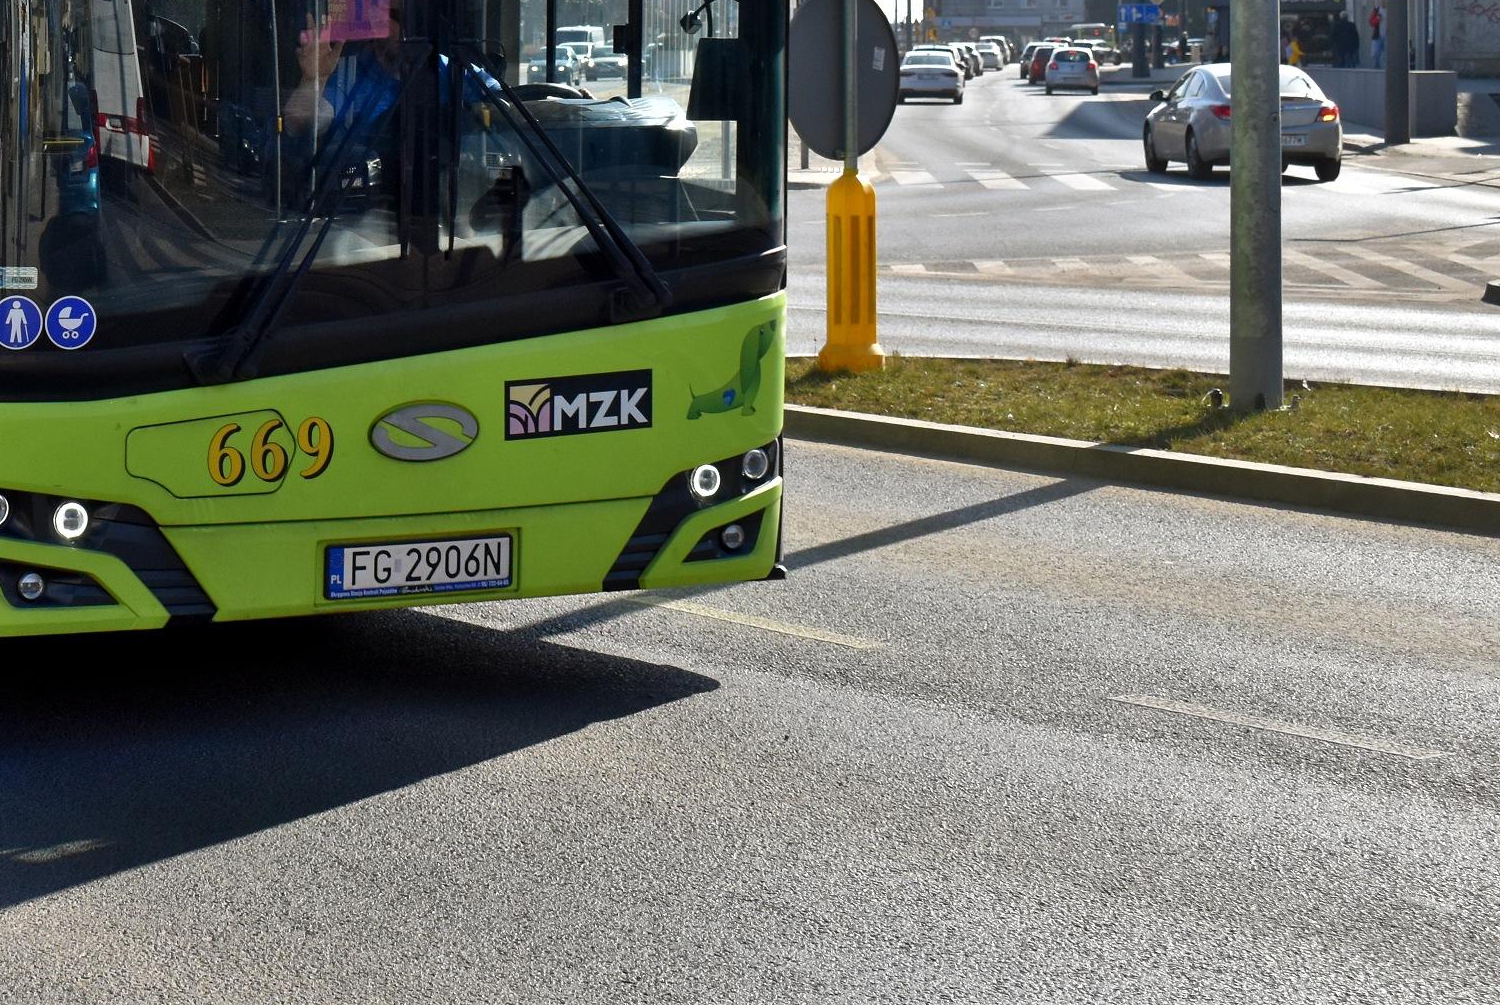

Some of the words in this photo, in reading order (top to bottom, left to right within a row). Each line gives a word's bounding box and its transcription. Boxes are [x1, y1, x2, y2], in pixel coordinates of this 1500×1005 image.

[553, 387, 649, 431] MZK
[207, 416, 335, 487] 669
[330, 575, 342, 584] PL
[352, 550, 392, 585] FG
[405, 542, 501, 581] 2906N
